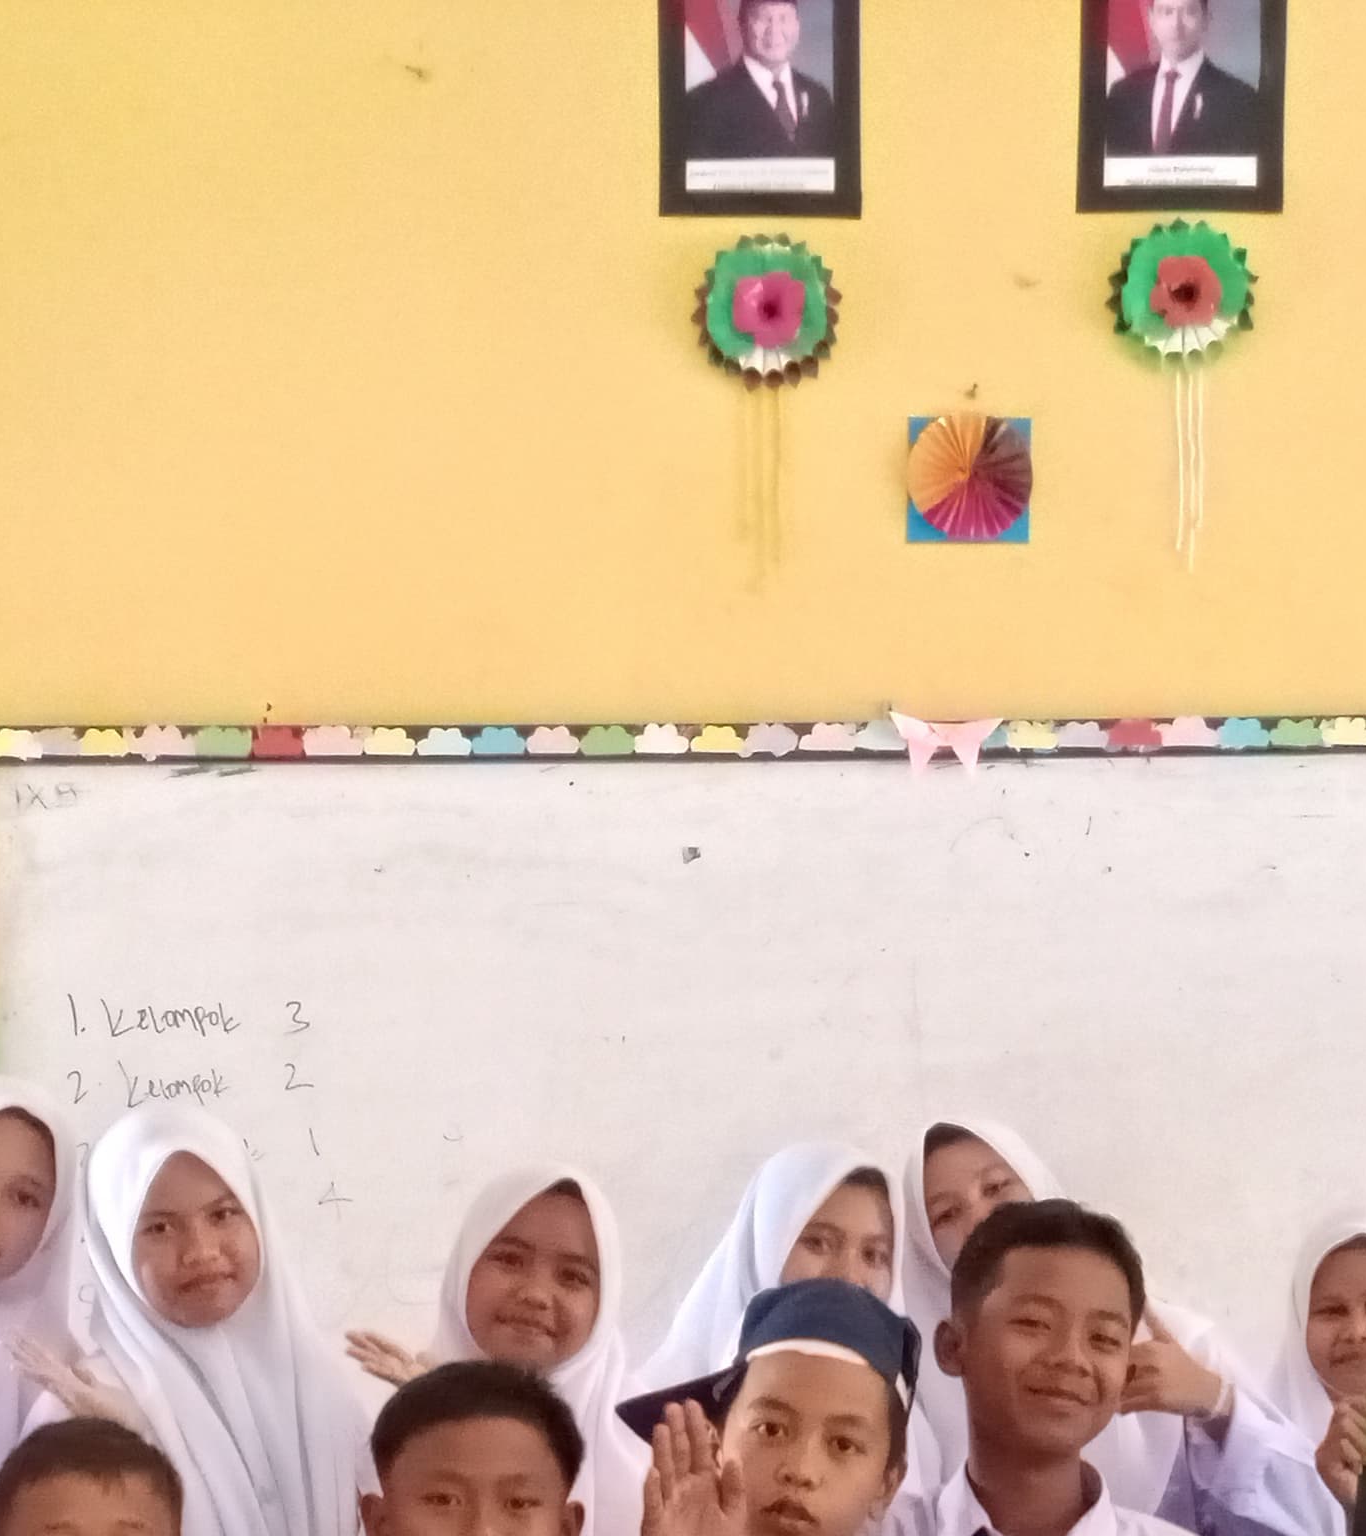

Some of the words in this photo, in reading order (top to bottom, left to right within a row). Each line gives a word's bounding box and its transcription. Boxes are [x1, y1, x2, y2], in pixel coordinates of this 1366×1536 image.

[100, 998, 241, 1037] Kelompok
[284, 1001, 310, 1034] 3
[118, 1060, 232, 1108] Kelompok
[284, 1063, 315, 1091] 2
